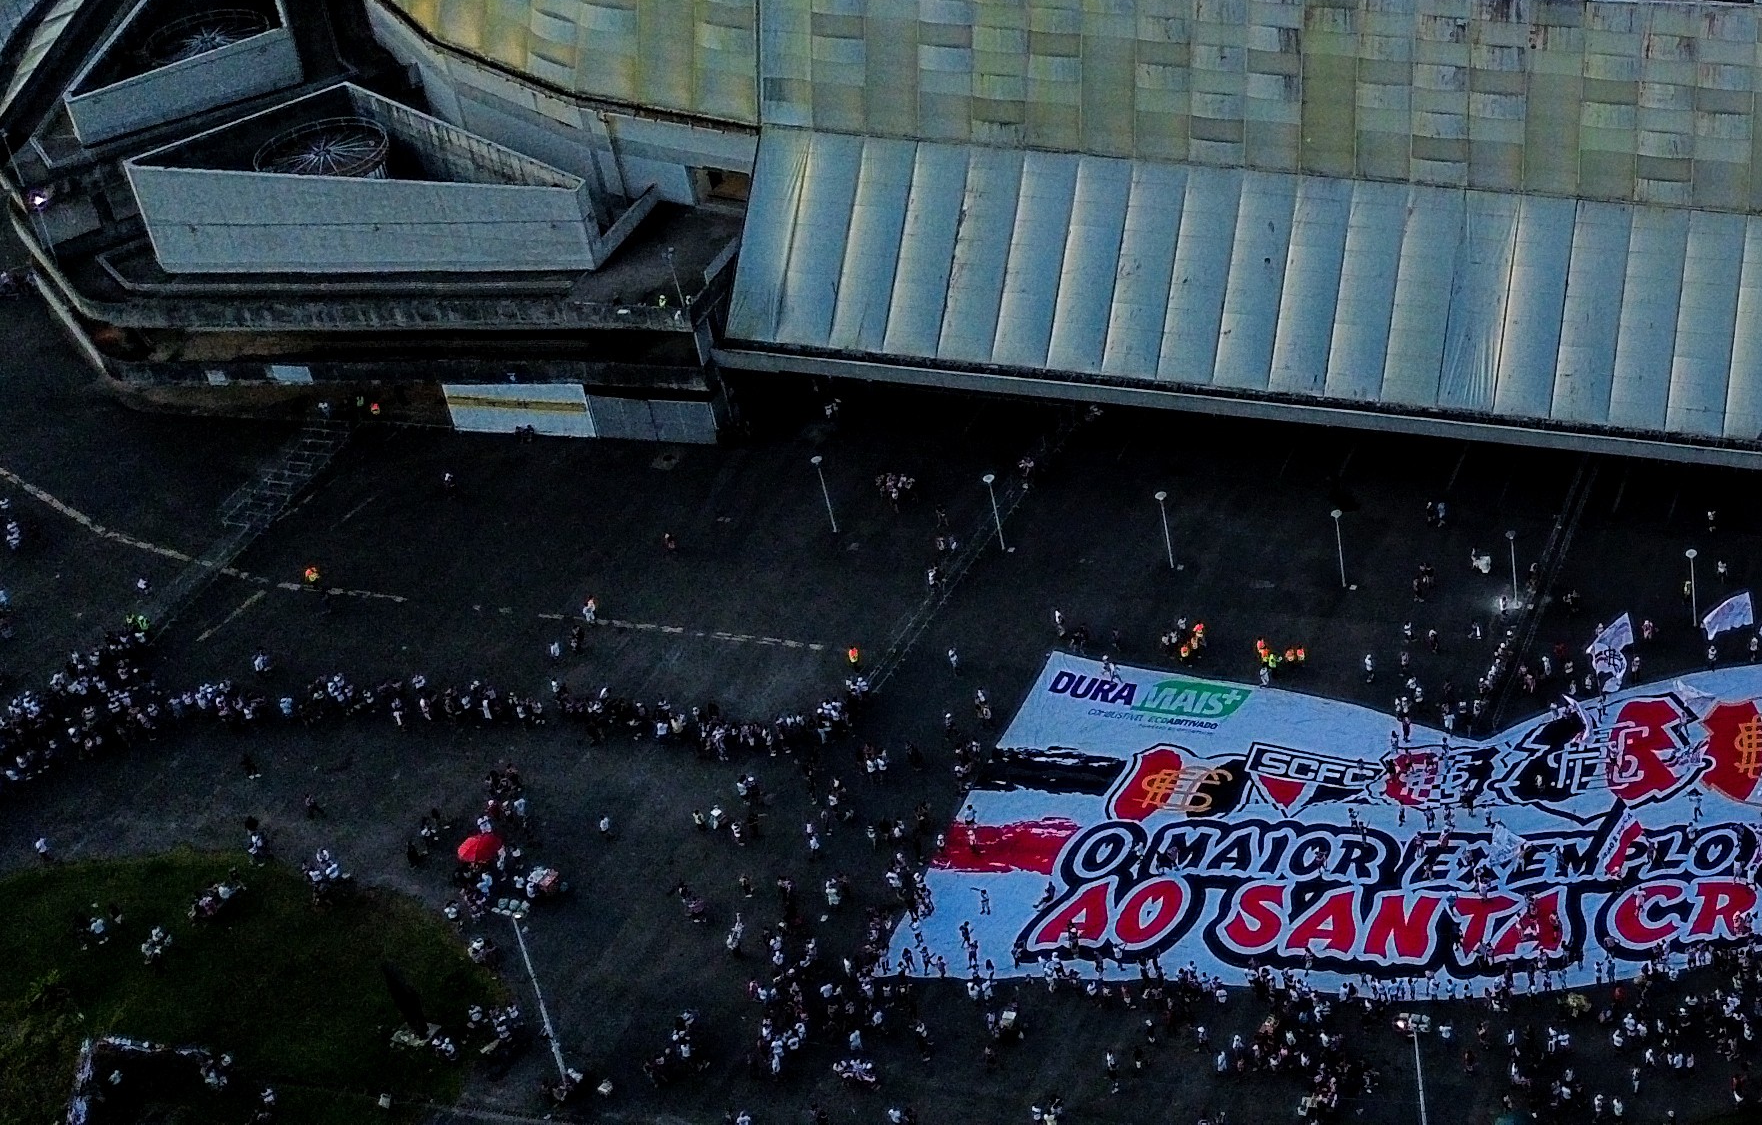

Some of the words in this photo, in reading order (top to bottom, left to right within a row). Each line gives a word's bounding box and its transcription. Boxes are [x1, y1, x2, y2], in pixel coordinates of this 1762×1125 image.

[1048, 670, 1137, 705] DURA
[1258, 750, 1377, 787] SCFC
[1082, 827, 1133, 875] O
[1159, 825, 1382, 879] MAIOR
[1033, 877, 1187, 948] AO
[1224, 881, 1563, 961] SANTA
